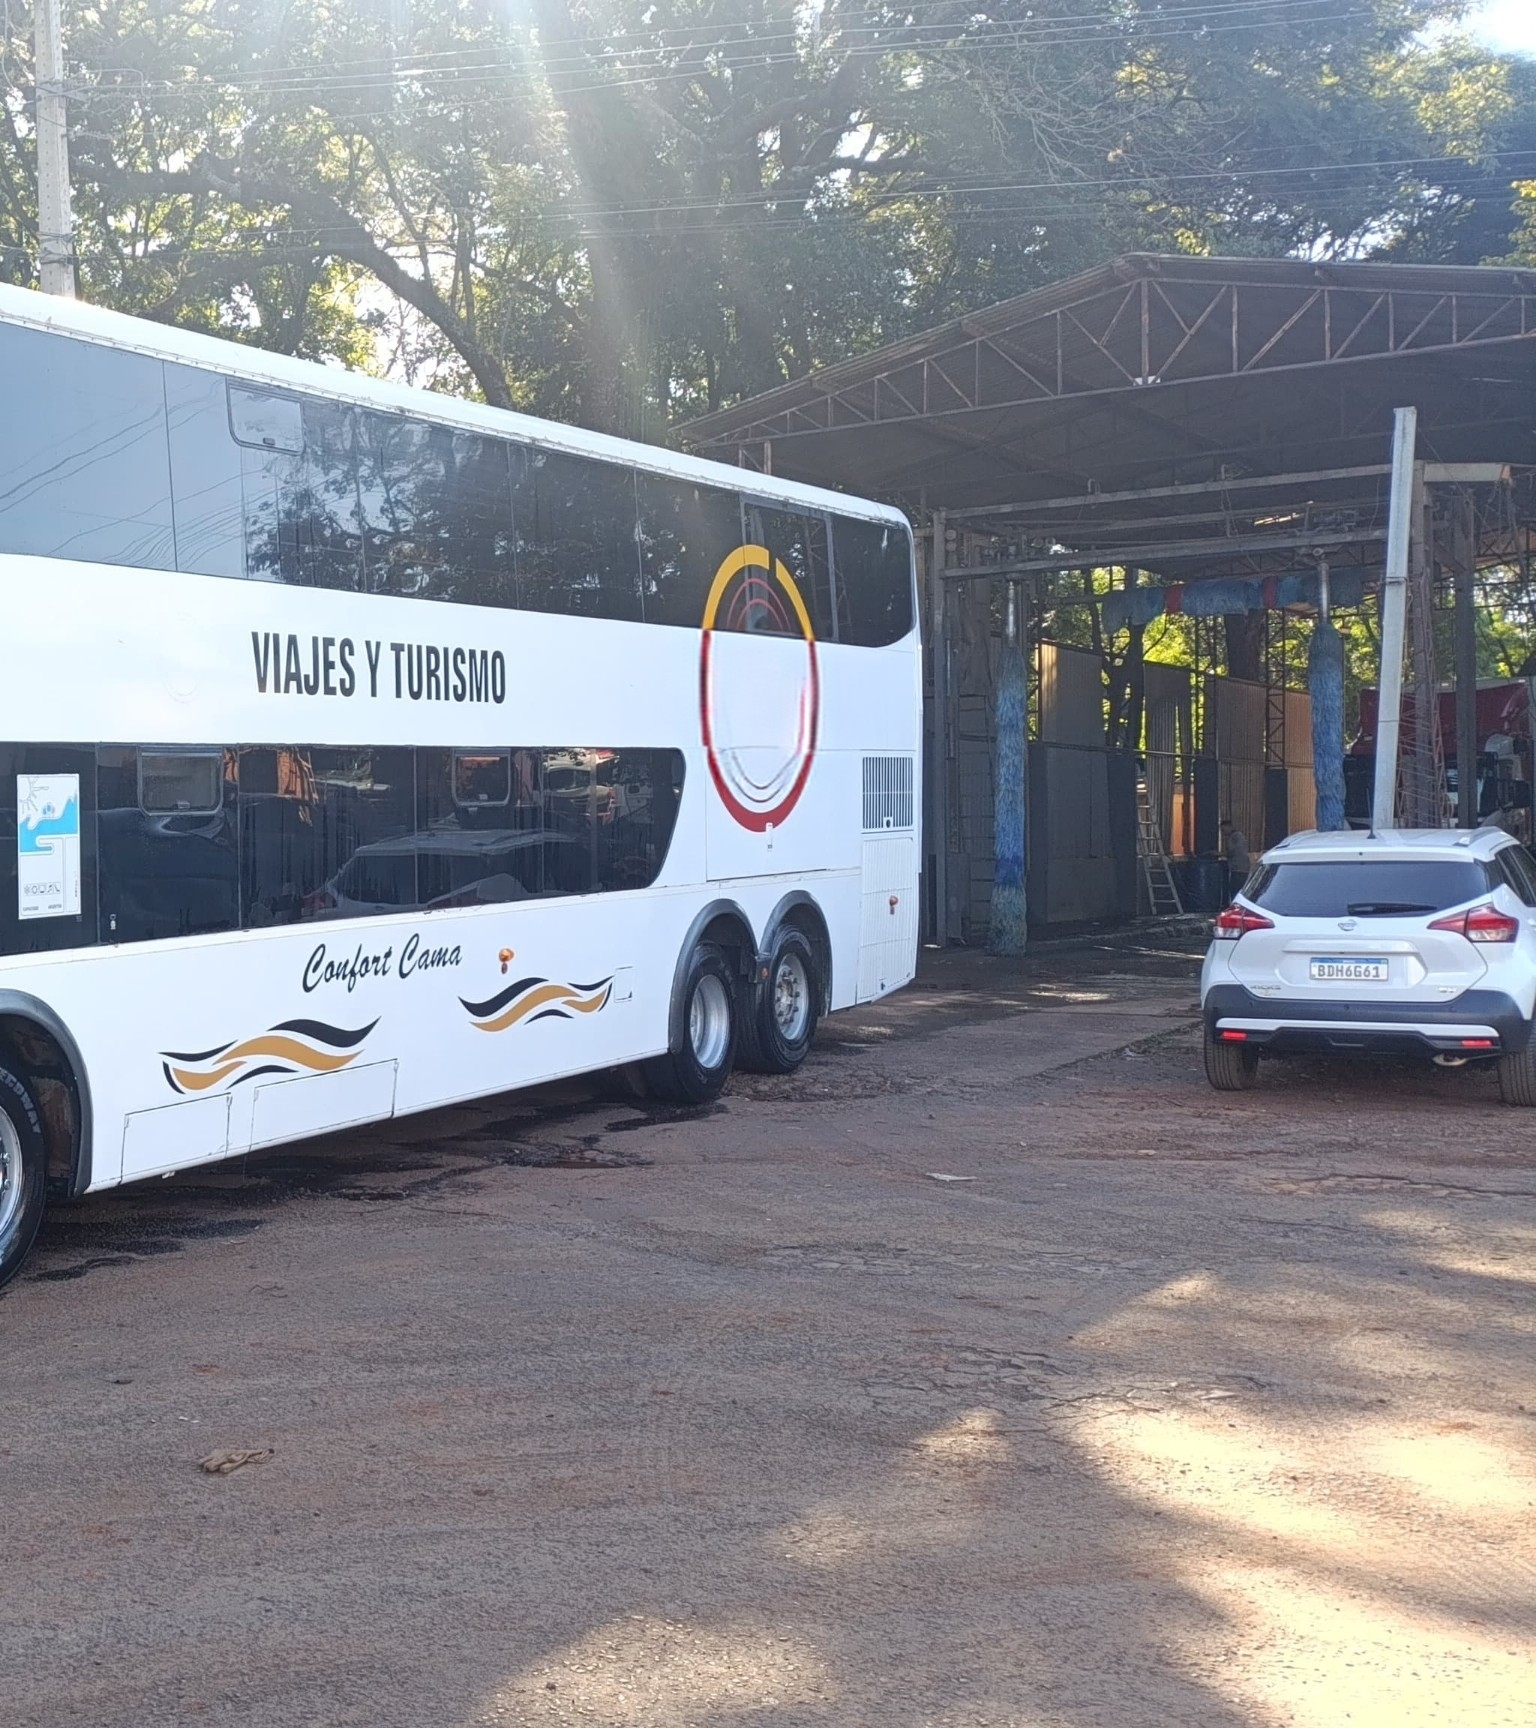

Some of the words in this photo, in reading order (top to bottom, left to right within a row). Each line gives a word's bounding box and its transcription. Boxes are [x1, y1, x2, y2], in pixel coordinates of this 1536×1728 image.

[251, 631, 355, 697] VIAJES
[364, 640, 381, 698] Y
[390, 642, 506, 704] TURISMO
[302, 943, 392, 993] Confort
[398, 933, 463, 979] Cama
[1317, 964, 1380, 978] BDH6G61
